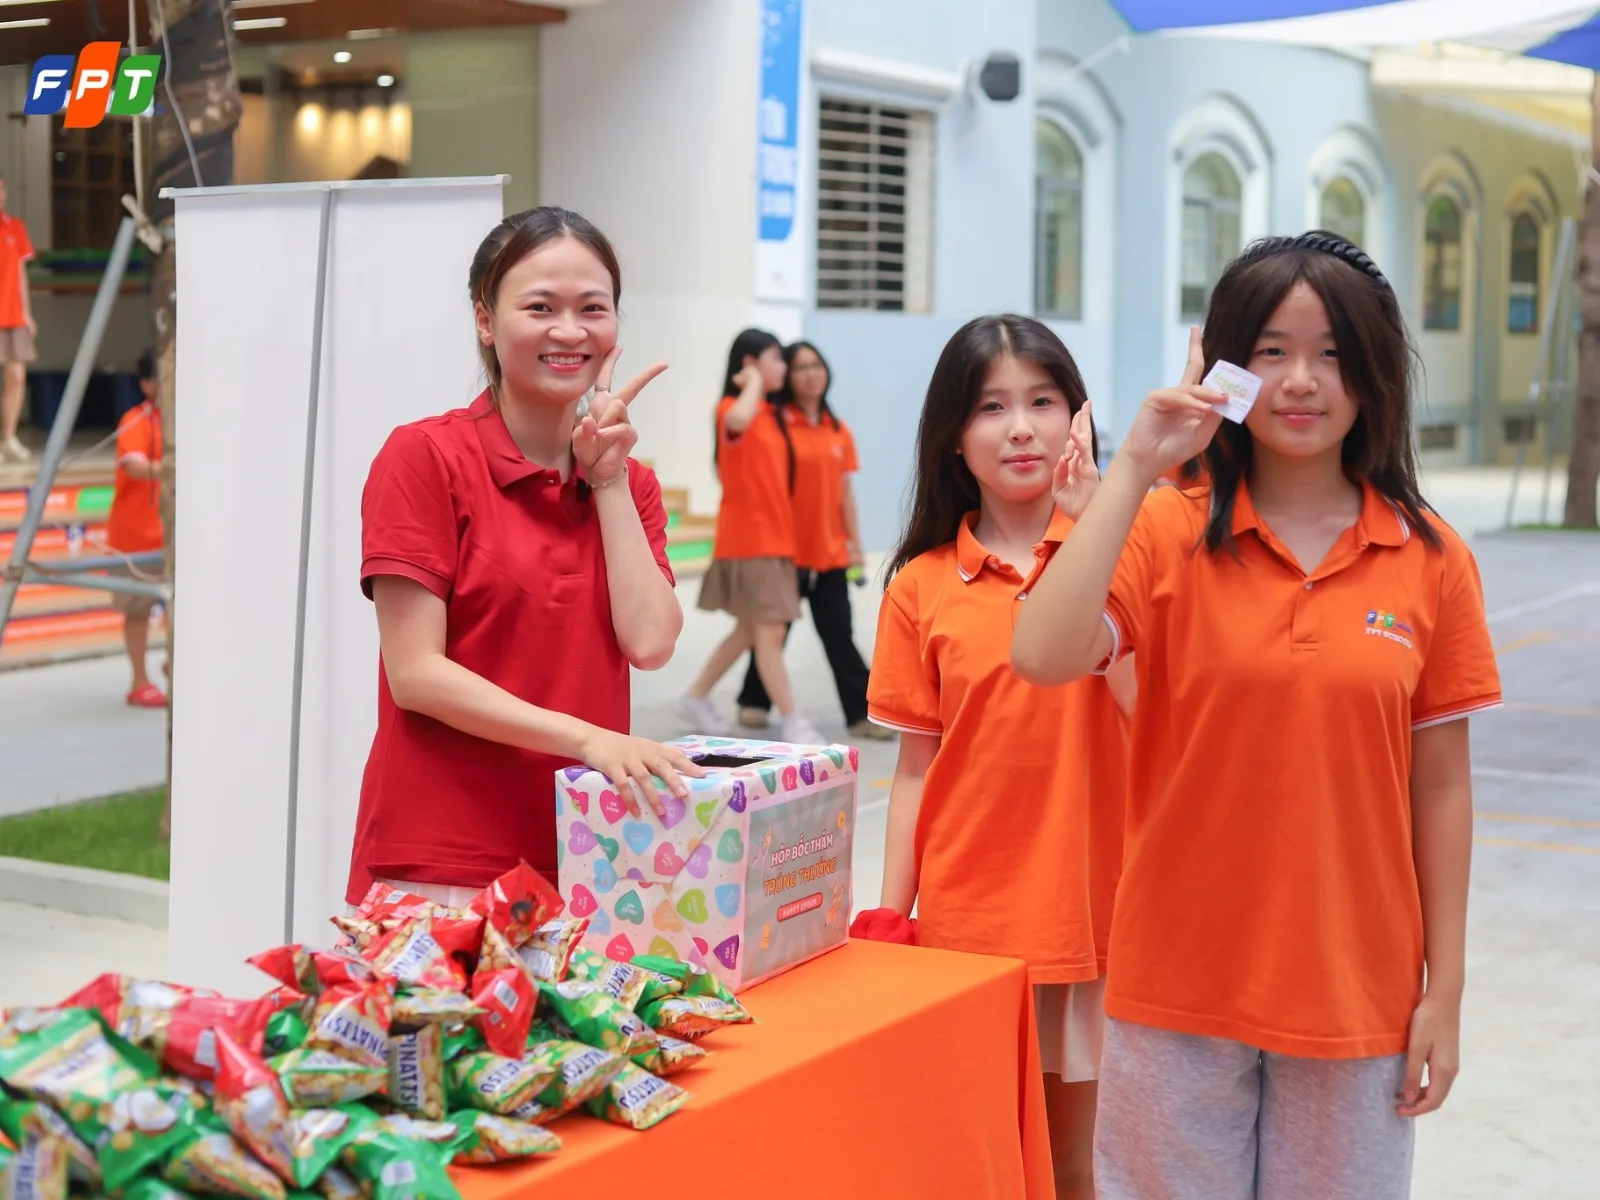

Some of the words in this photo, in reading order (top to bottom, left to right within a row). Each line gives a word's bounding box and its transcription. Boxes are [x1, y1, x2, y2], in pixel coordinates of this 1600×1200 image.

[1367, 612, 1395, 624] FPT
[771, 843, 791, 869] HỘP
[792, 832, 809, 860] BỐC
[810, 829, 834, 854] THĂM
